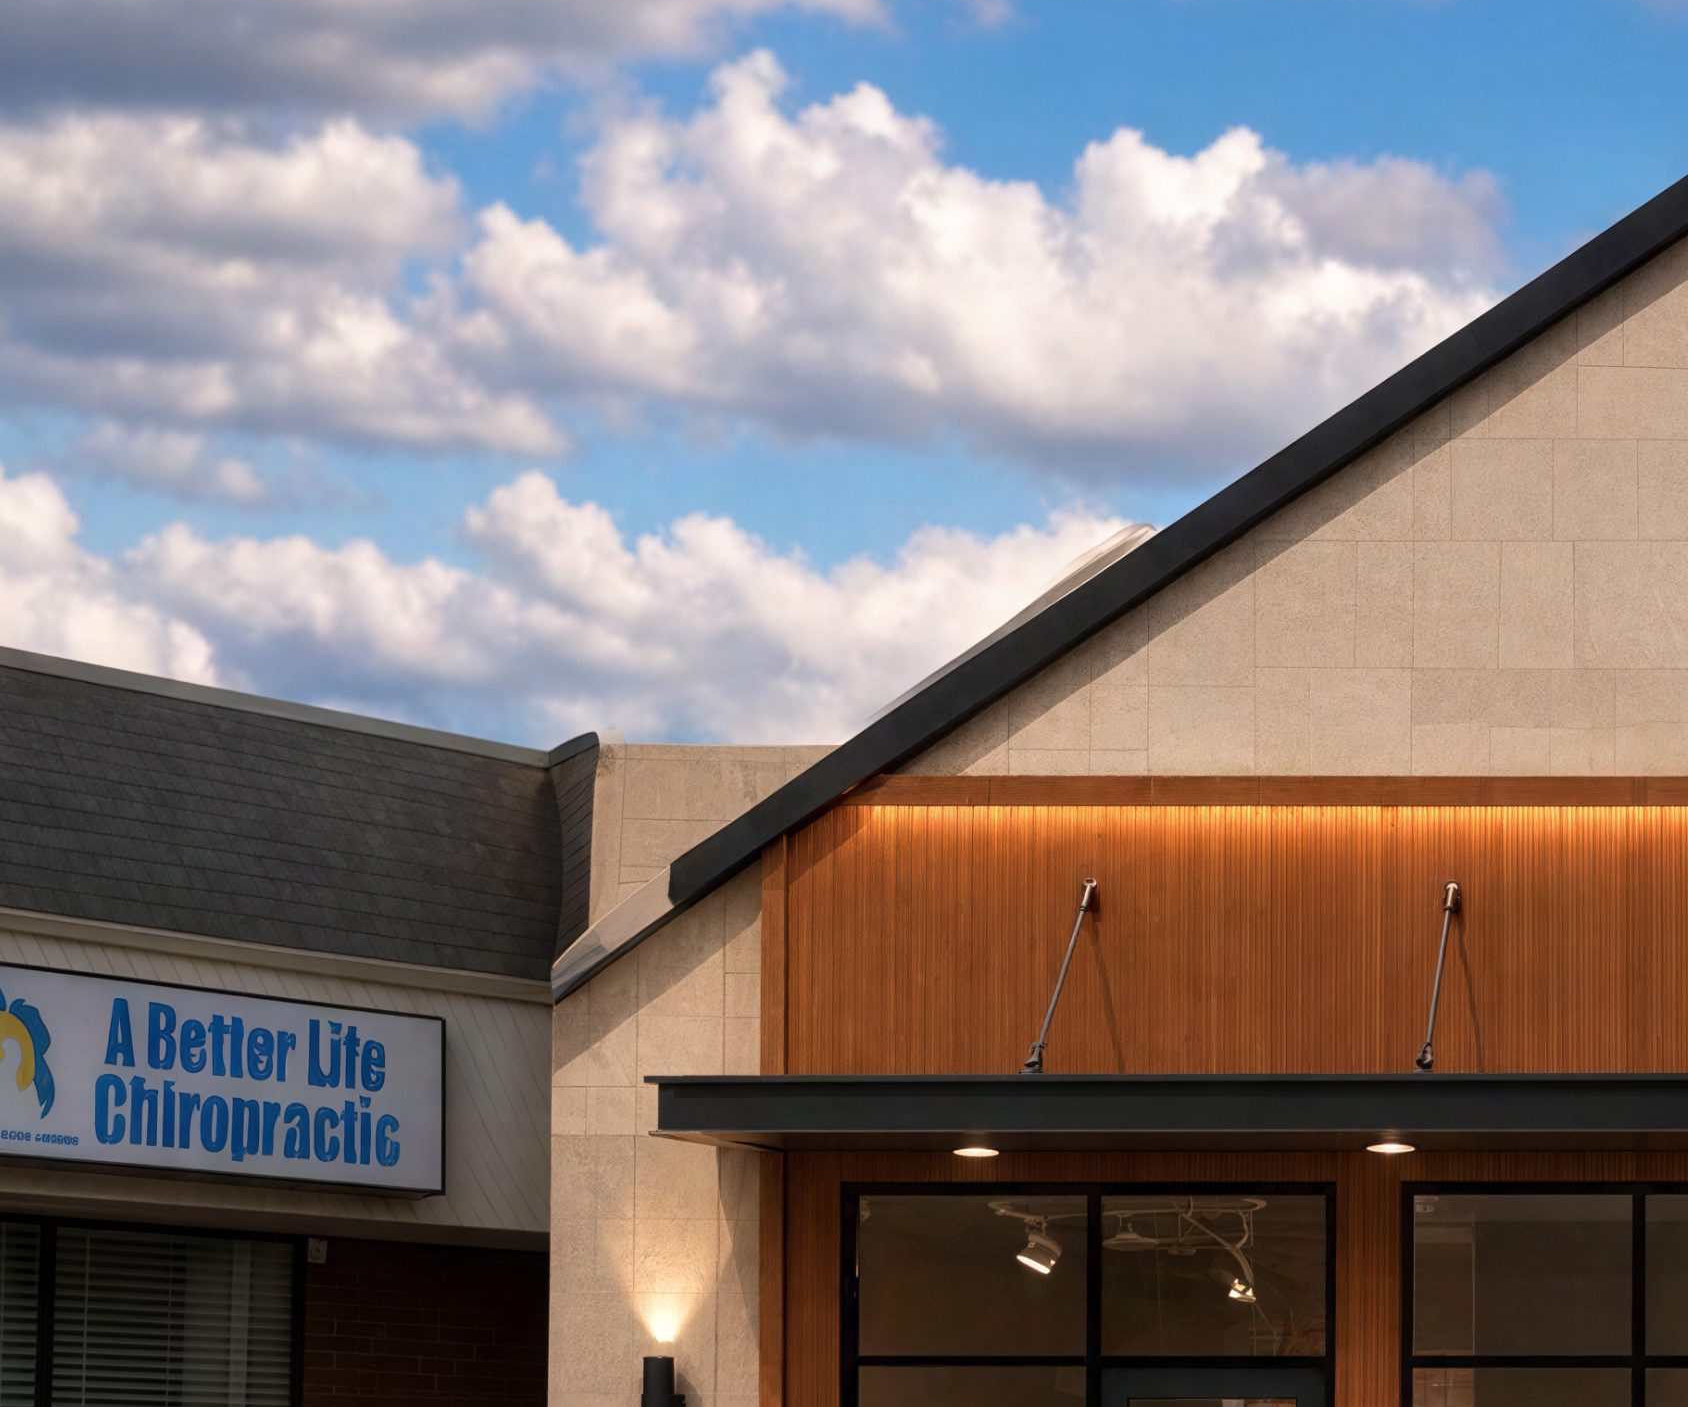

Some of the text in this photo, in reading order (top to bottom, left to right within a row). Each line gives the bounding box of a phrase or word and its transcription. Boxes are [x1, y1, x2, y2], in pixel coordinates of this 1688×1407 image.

[104, 997, 135, 1068] A
[147, 1001, 297, 1082] Better
[94, 1073, 400, 1167] Chiropractic
